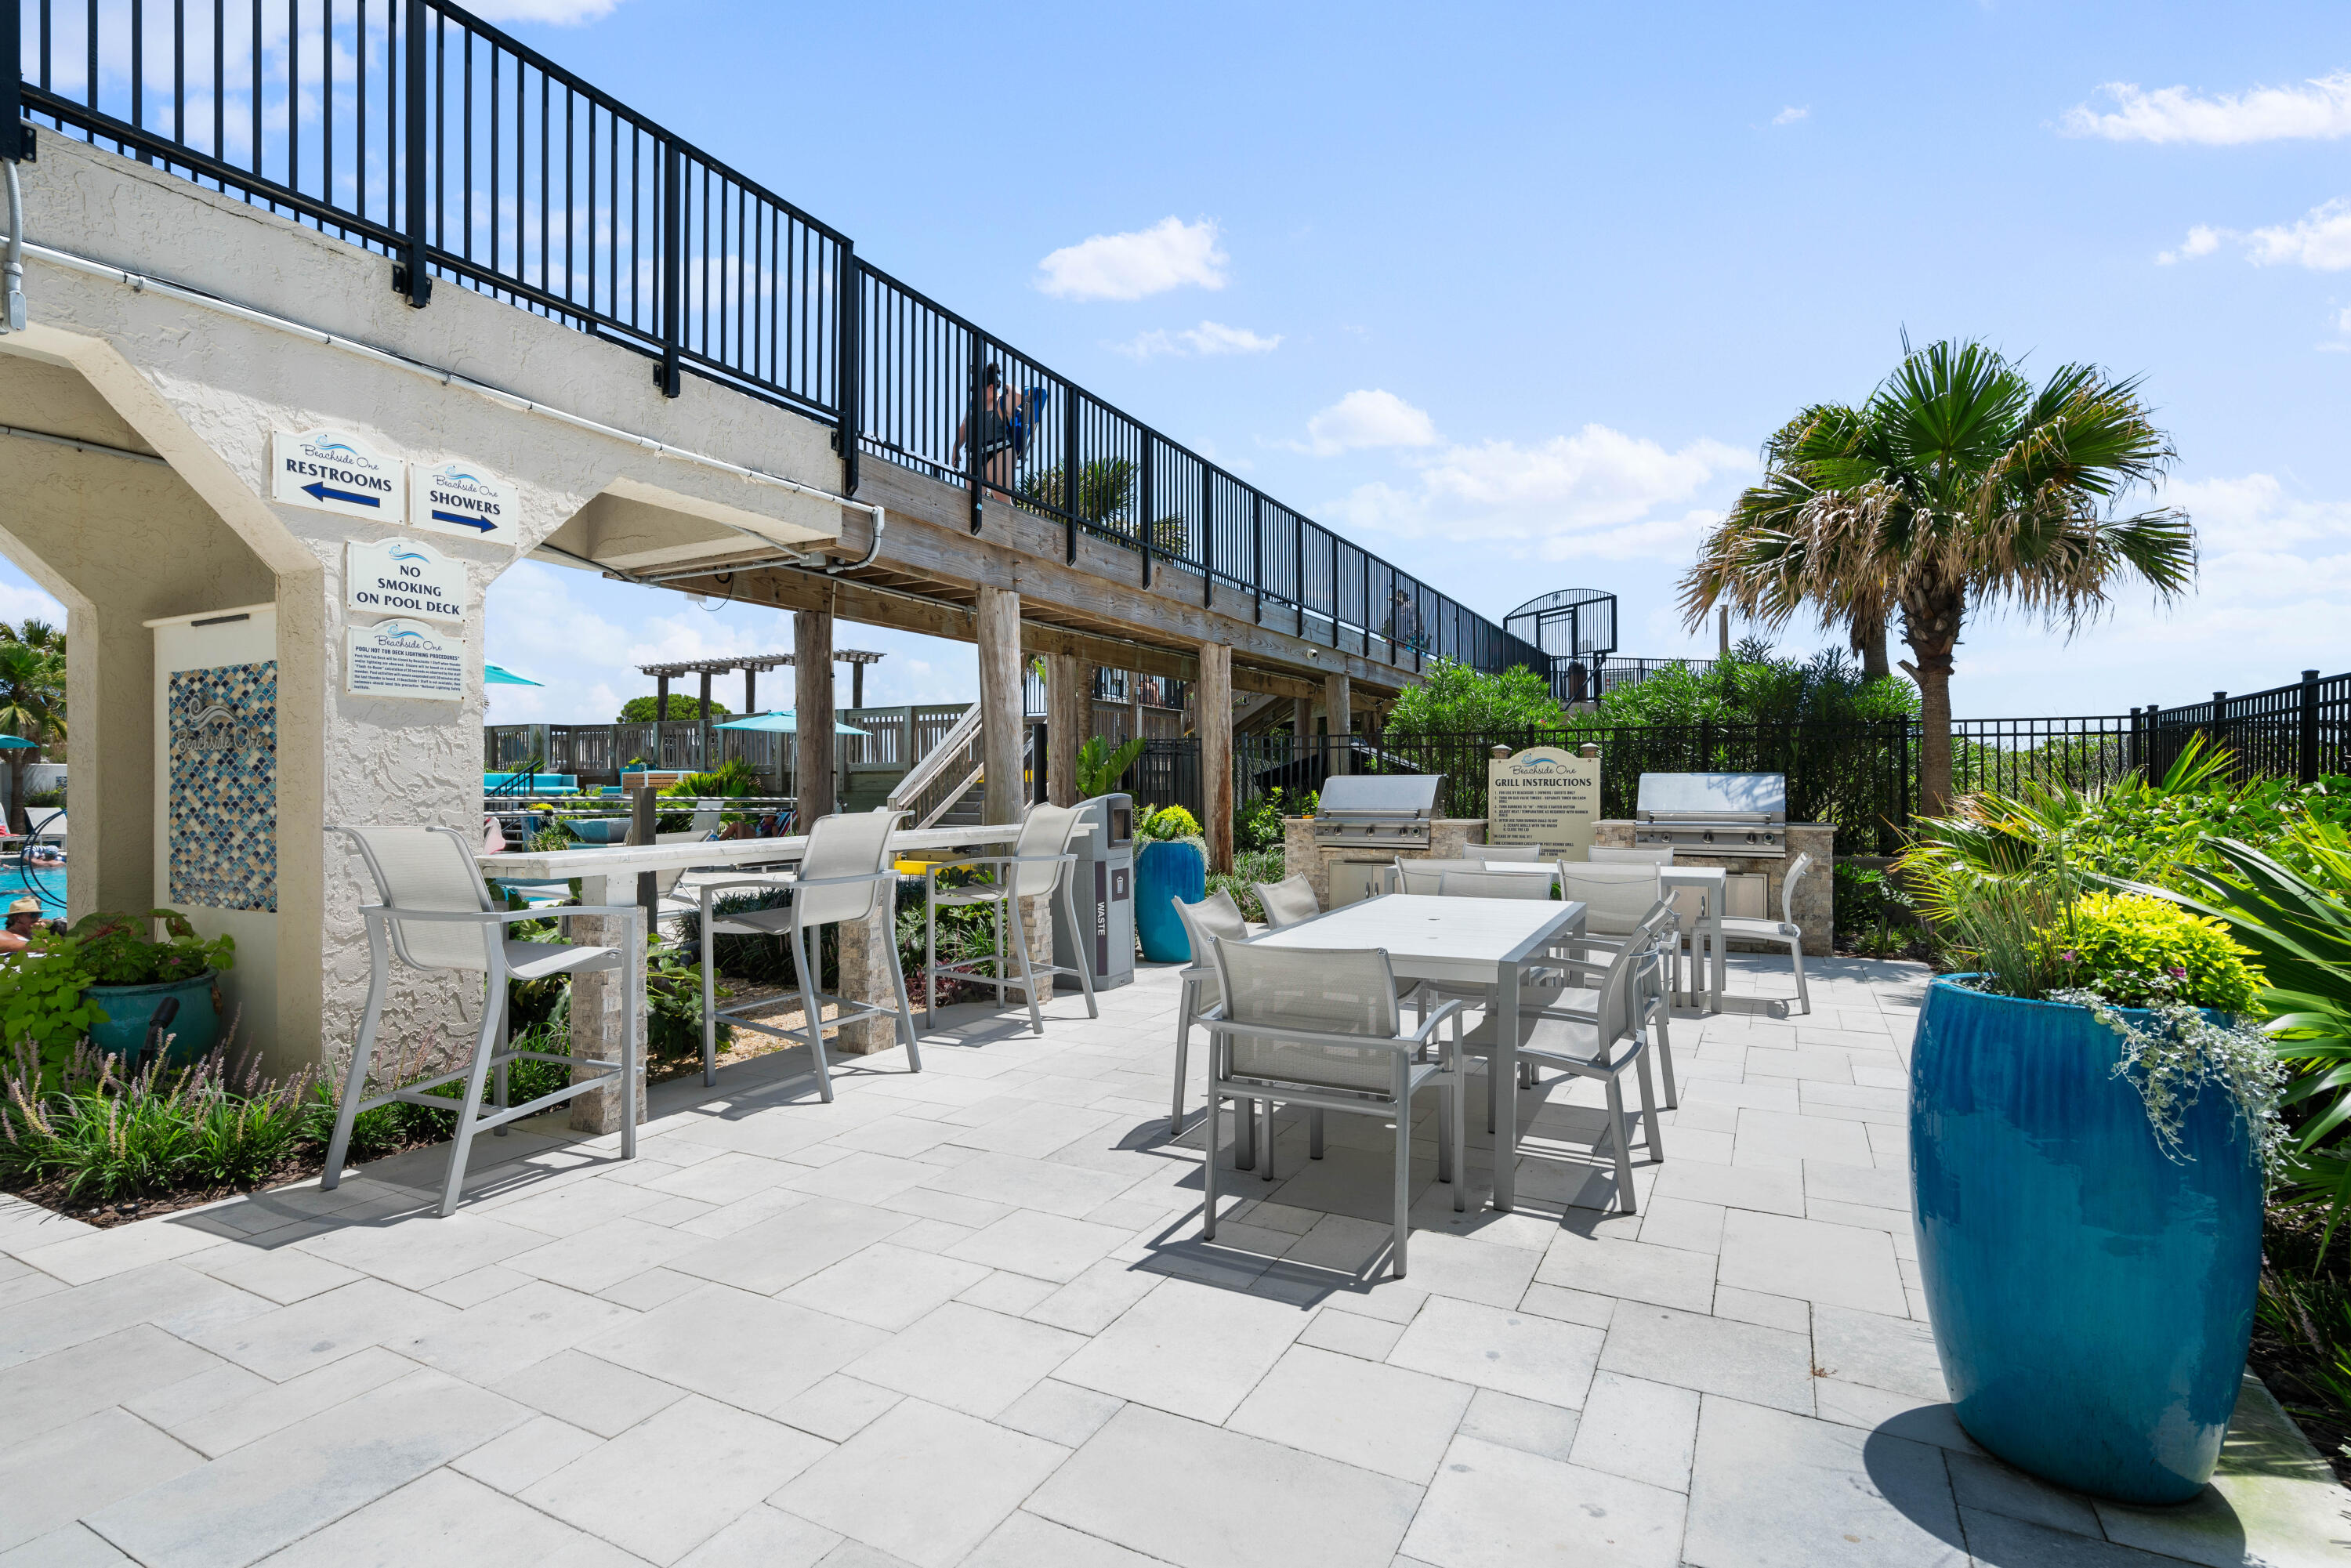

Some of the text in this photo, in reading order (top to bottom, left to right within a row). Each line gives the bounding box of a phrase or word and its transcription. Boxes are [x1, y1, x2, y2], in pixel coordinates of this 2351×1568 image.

[300, 444, 380, 470] Beachside One
[286, 458, 393, 492] RESTROOMS
[433, 475, 498, 498] Beachside One
[430, 491, 501, 515] SHOWERS
[400, 565, 421, 578] NO
[378, 578, 441, 597] SMOKING
[357, 592, 460, 615] ON POOL DECK
[375, 635, 443, 651] Beachside One
[173, 726, 263, 753] Beachside One
[1509, 765, 1577, 775] Beachside One
[1495, 778, 1592, 787] GRILL INSTRUCTIONS
[1097, 901, 1106, 936] WASTE
